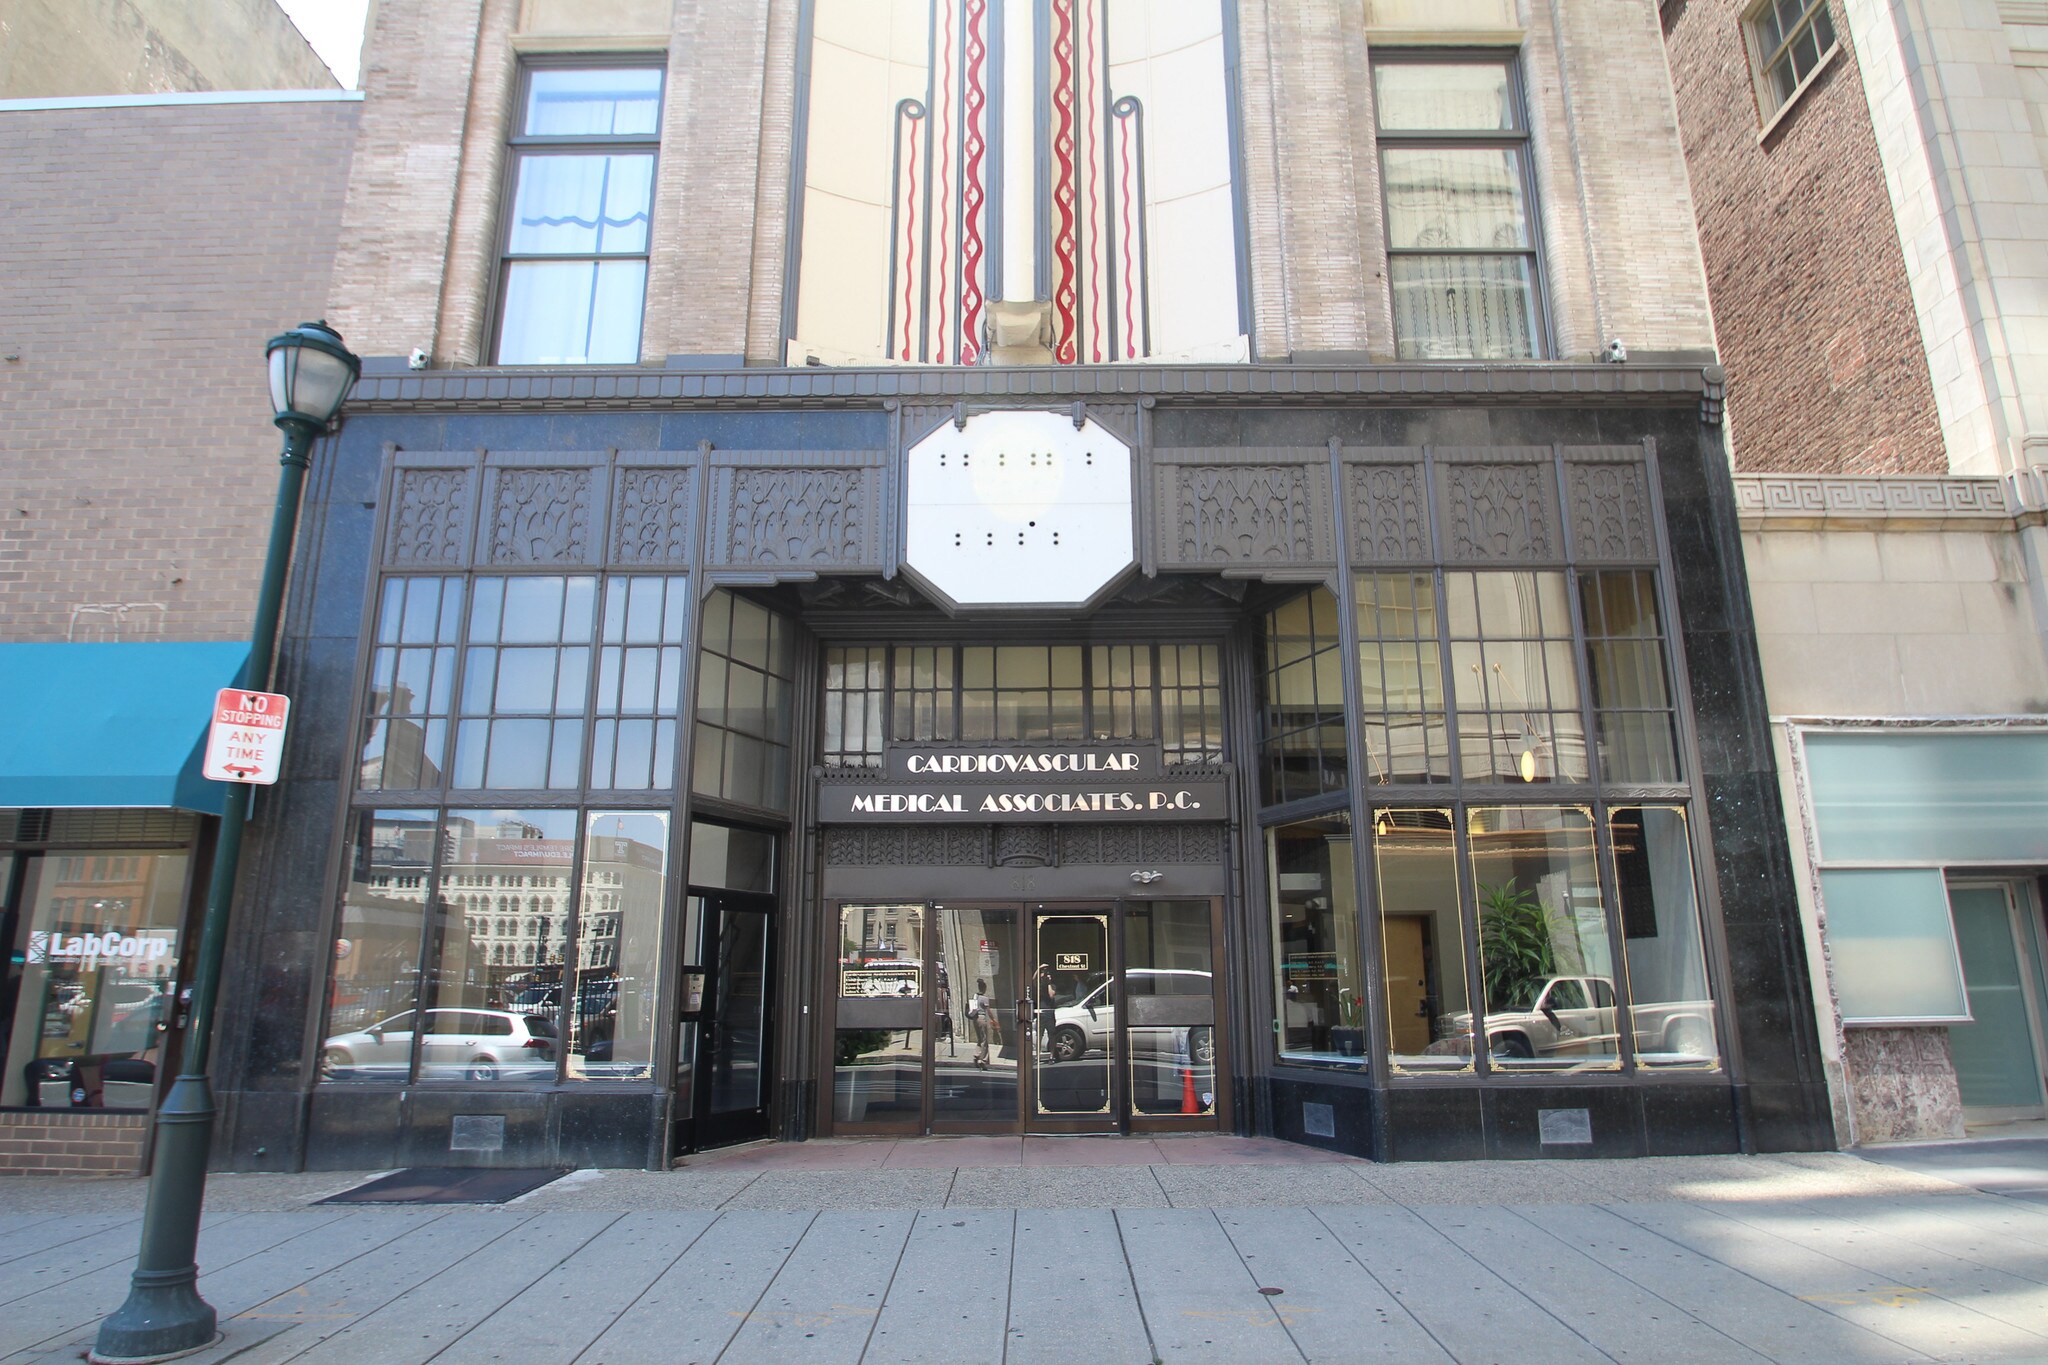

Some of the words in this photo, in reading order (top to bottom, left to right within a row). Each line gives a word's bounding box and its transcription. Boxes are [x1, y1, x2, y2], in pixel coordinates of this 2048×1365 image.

[239, 694, 268, 713] NO
[221, 709, 281, 727] STOPPING
[229, 731, 267, 745] ANY
[226, 746, 265, 761] TIME
[907, 753, 1139, 773] CARDIOVASCULAR
[850, 794, 969, 813] MEDICAL
[1149, 790, 1202, 810] P.C.
[49, 932, 168, 961] LabCorp
